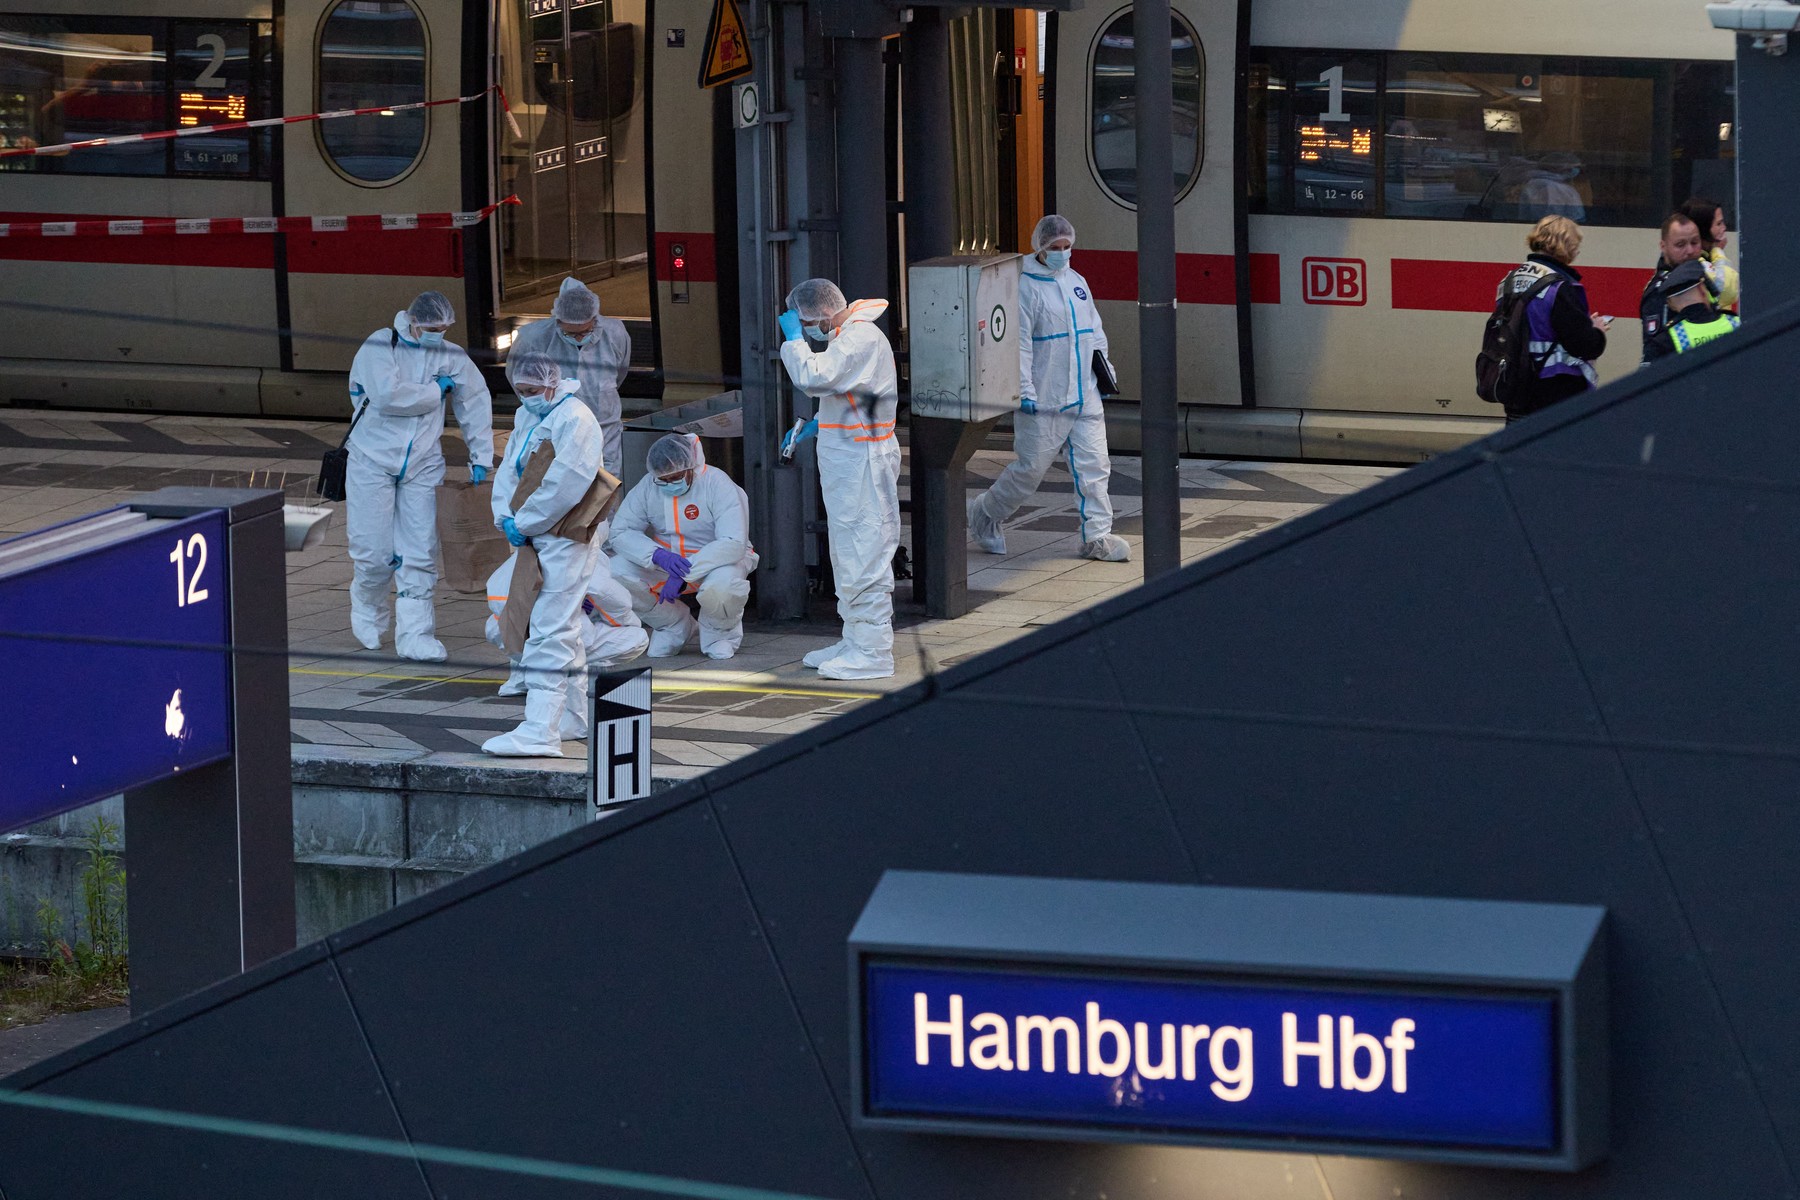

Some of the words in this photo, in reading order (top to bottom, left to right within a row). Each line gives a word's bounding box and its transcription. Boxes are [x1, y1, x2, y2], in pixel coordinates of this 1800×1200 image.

[195, 33, 226, 88] 2
[1320, 66, 1350, 121] 1
[198, 153, 209, 162] 61
[222, 153, 238, 163] 108
[1325, 189, 1337, 199] 12
[1351, 189, 1364, 200] 66
[1310, 264, 1360, 298] DB
[170, 532, 208, 607] 12
[608, 719, 640, 800] H
[913, 992, 1254, 1102] Hamburg
[1281, 1012, 1415, 1094] Hbf
